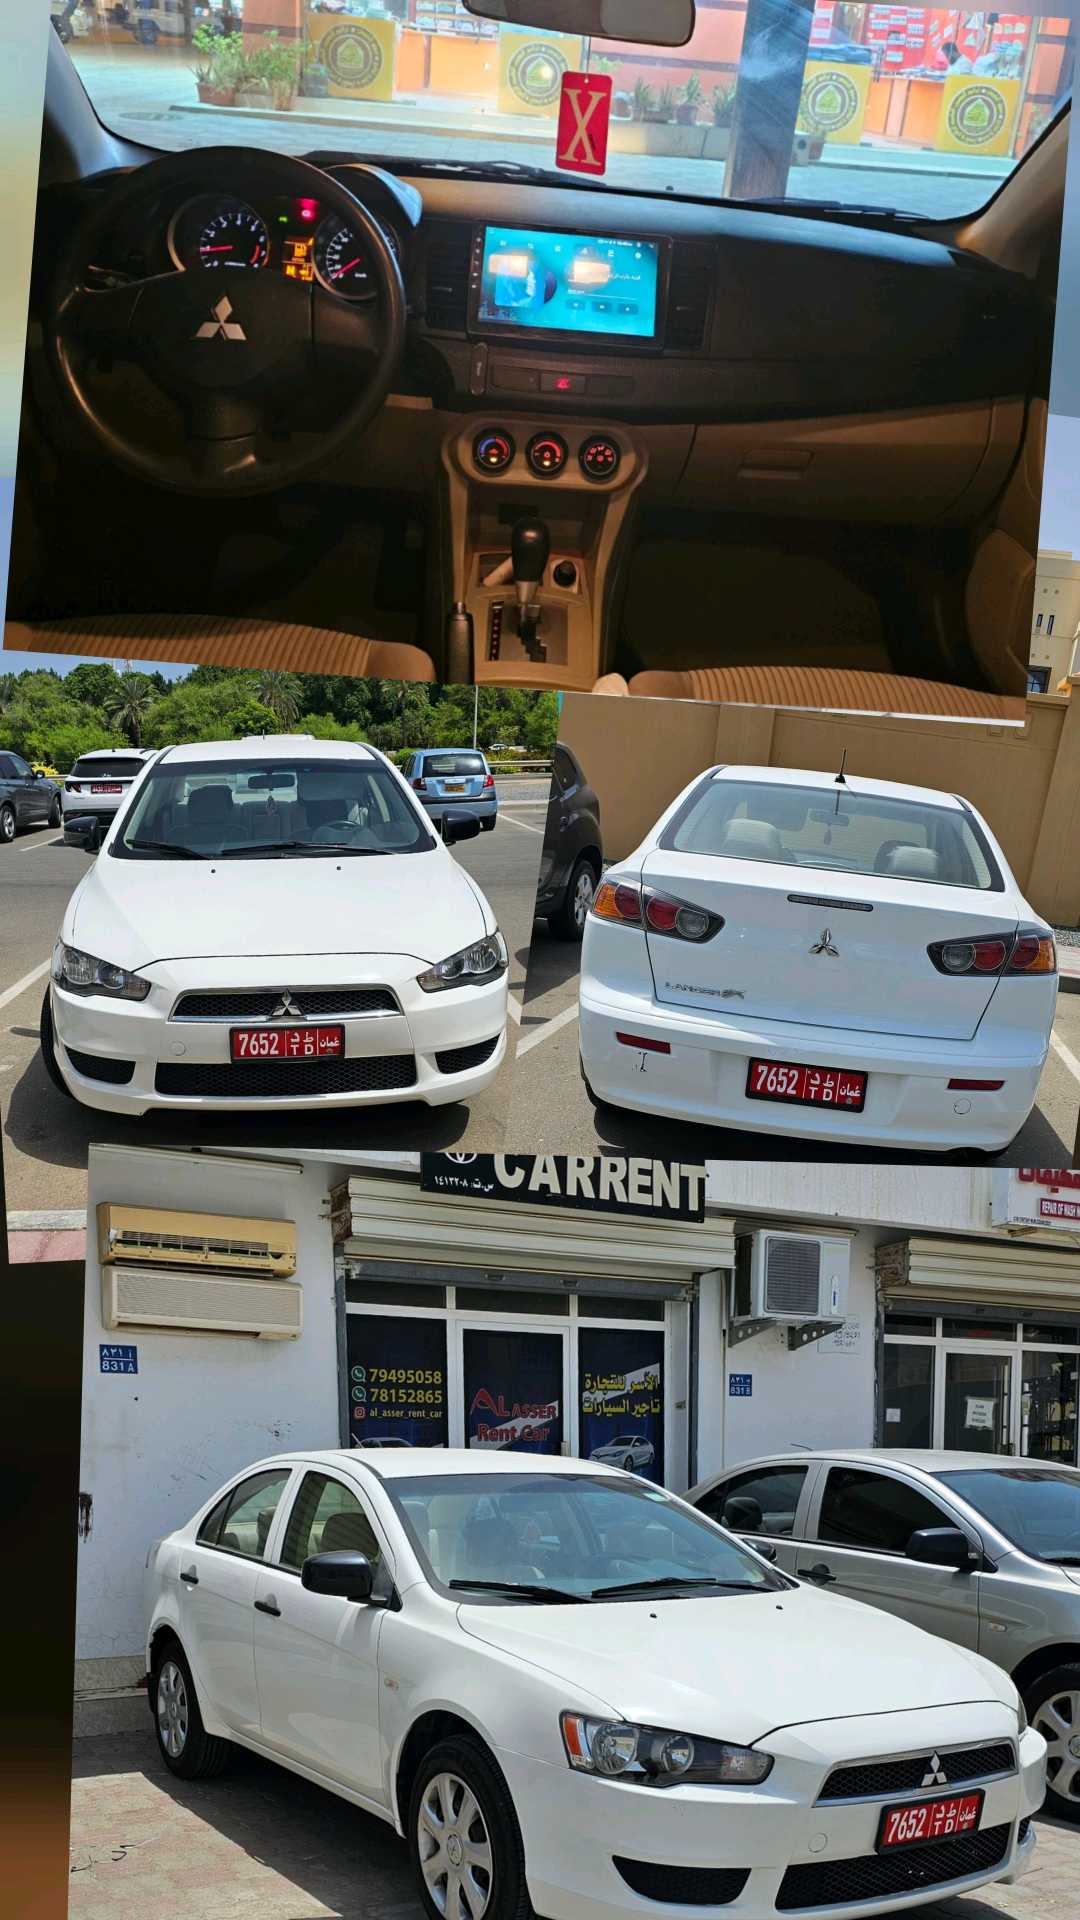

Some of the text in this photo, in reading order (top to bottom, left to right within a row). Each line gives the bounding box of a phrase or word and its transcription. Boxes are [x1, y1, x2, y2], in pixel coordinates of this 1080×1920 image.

[558, 87, 608, 166] X
[239, 1032, 279, 1056] 7652
[756, 1065, 799, 1095] 7652
[369, 1368, 442, 1385] 79495058
[369, 1388, 442, 1403] 78152865
[369, 1407, 443, 1419] al_asser_rent_car
[477, 1423, 550, 1441] Rent Car
[888, 1808, 927, 1843] 7652
